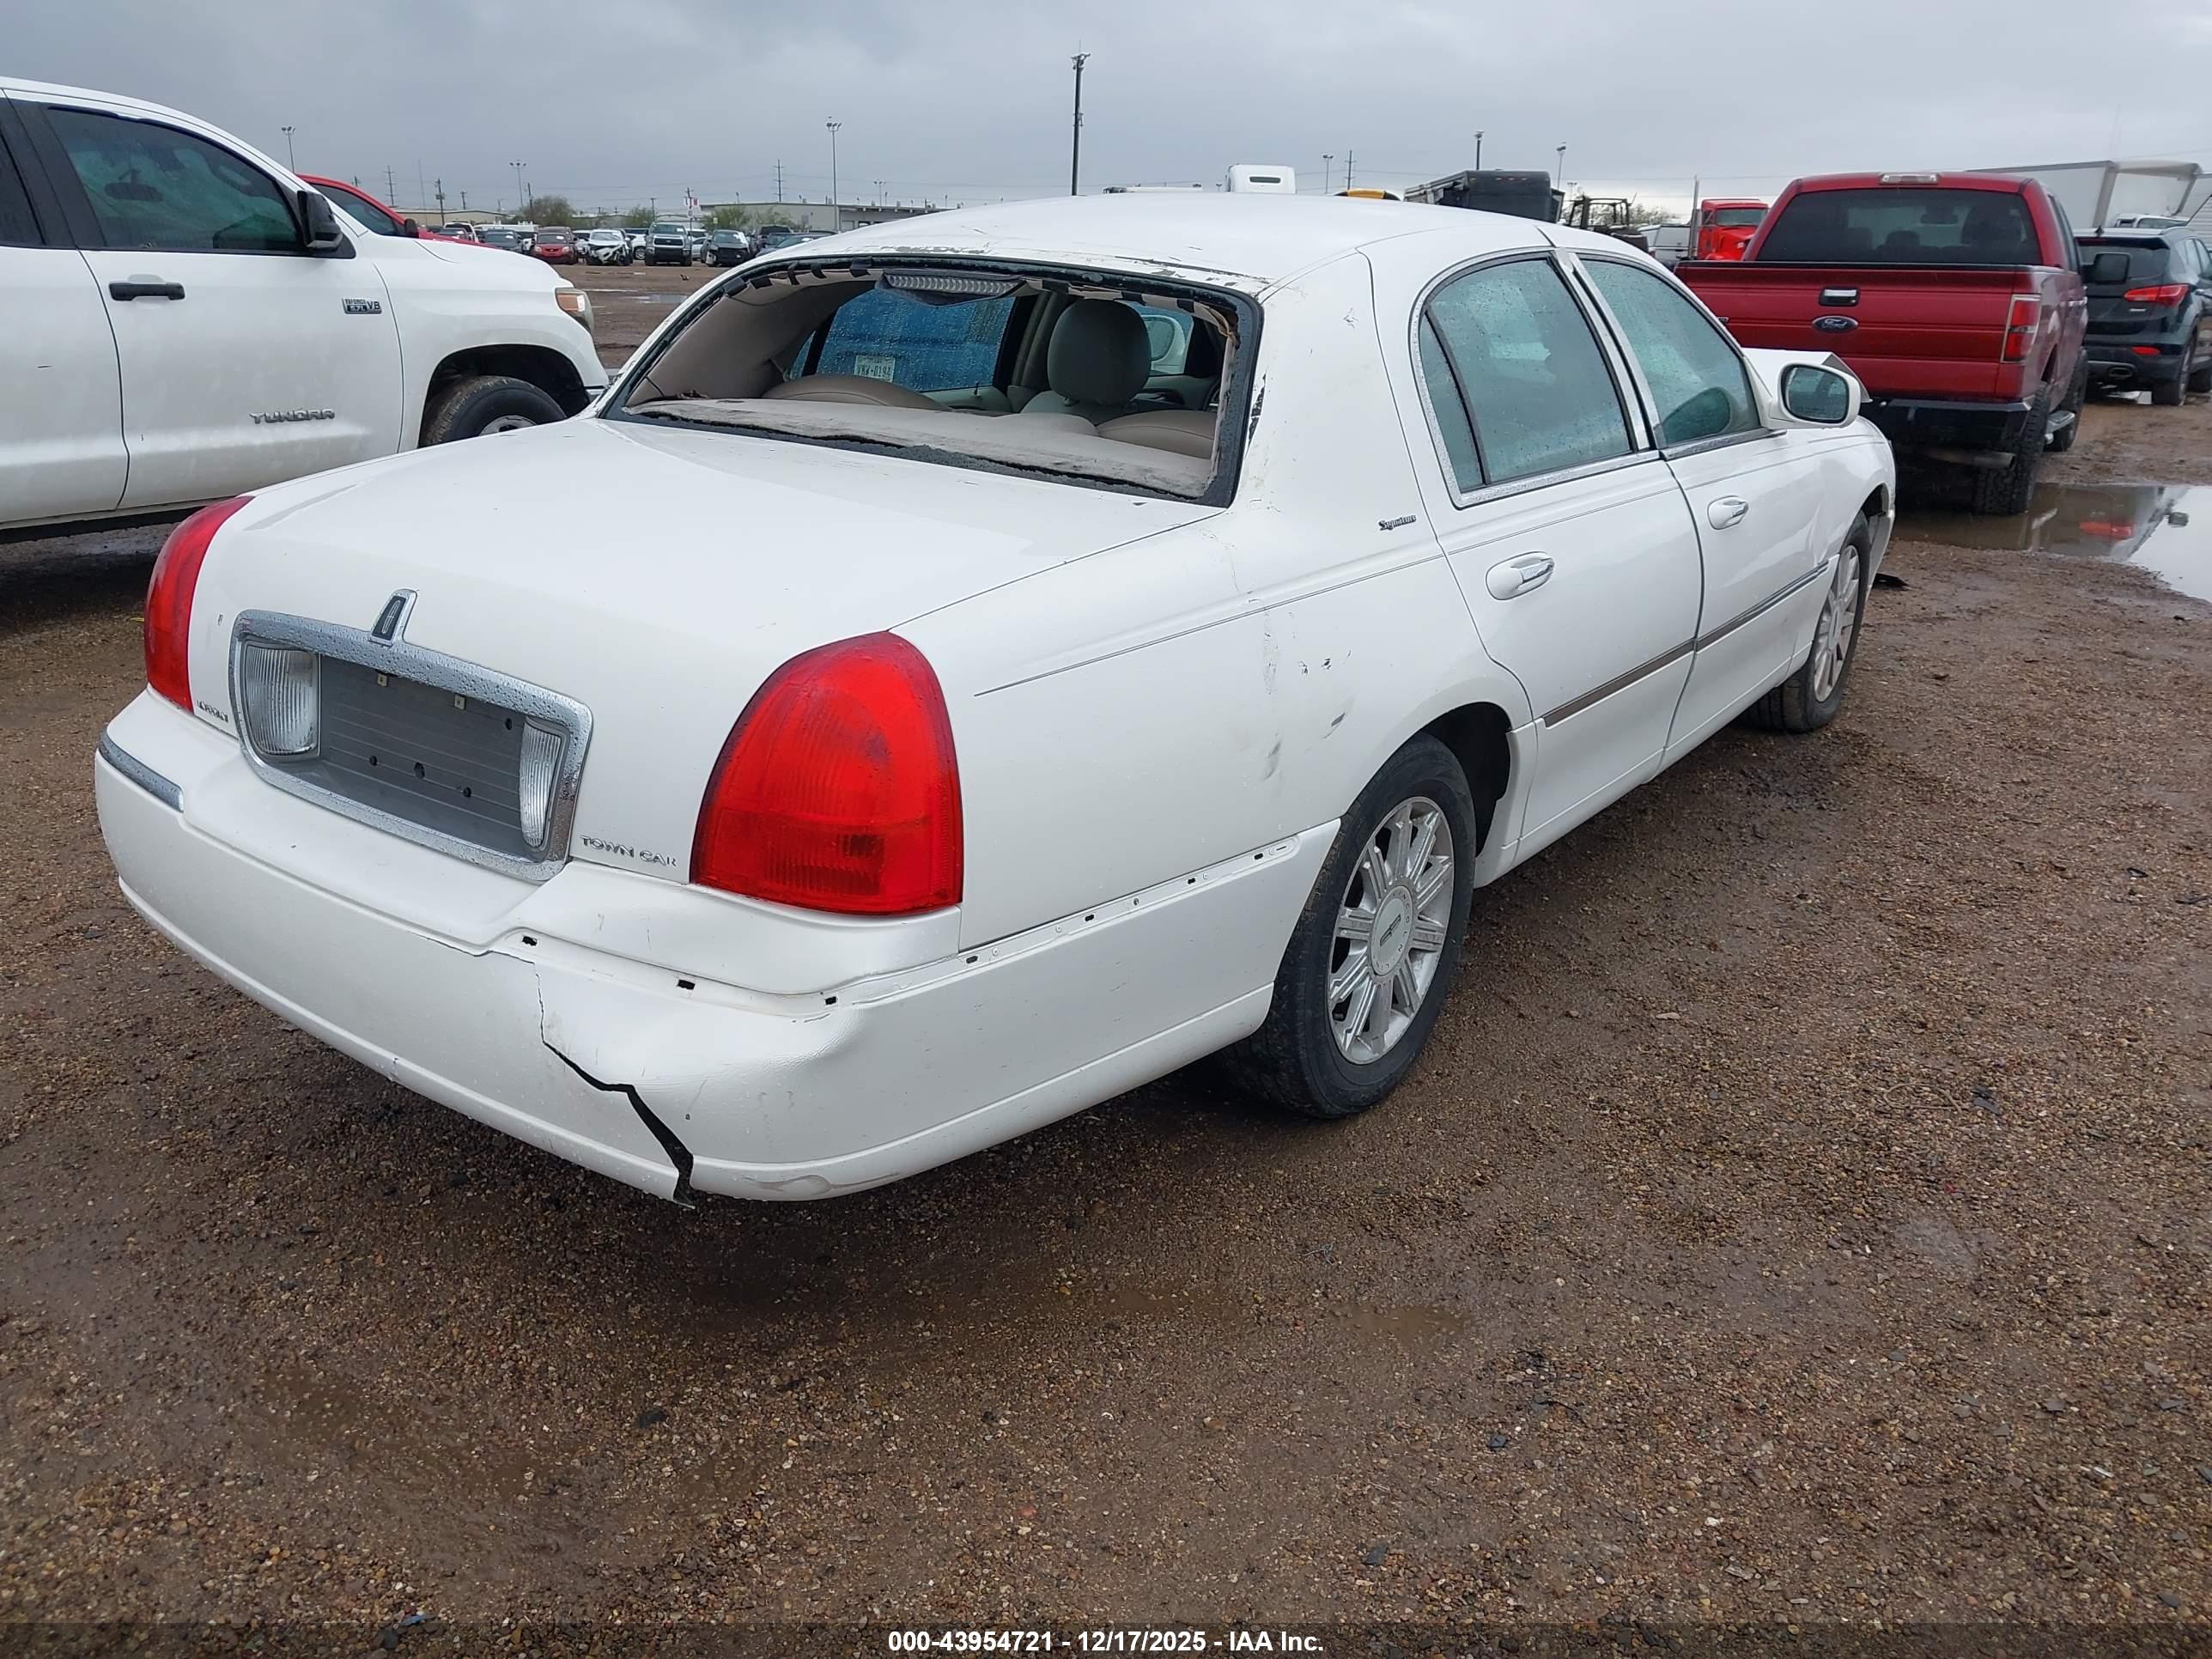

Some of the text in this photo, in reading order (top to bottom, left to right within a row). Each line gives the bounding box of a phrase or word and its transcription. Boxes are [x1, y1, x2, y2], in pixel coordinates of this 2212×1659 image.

[366, 301, 380, 310] V8
[248, 408, 335, 424] TUNDRA
[580, 835, 677, 867] TOWN CAR
